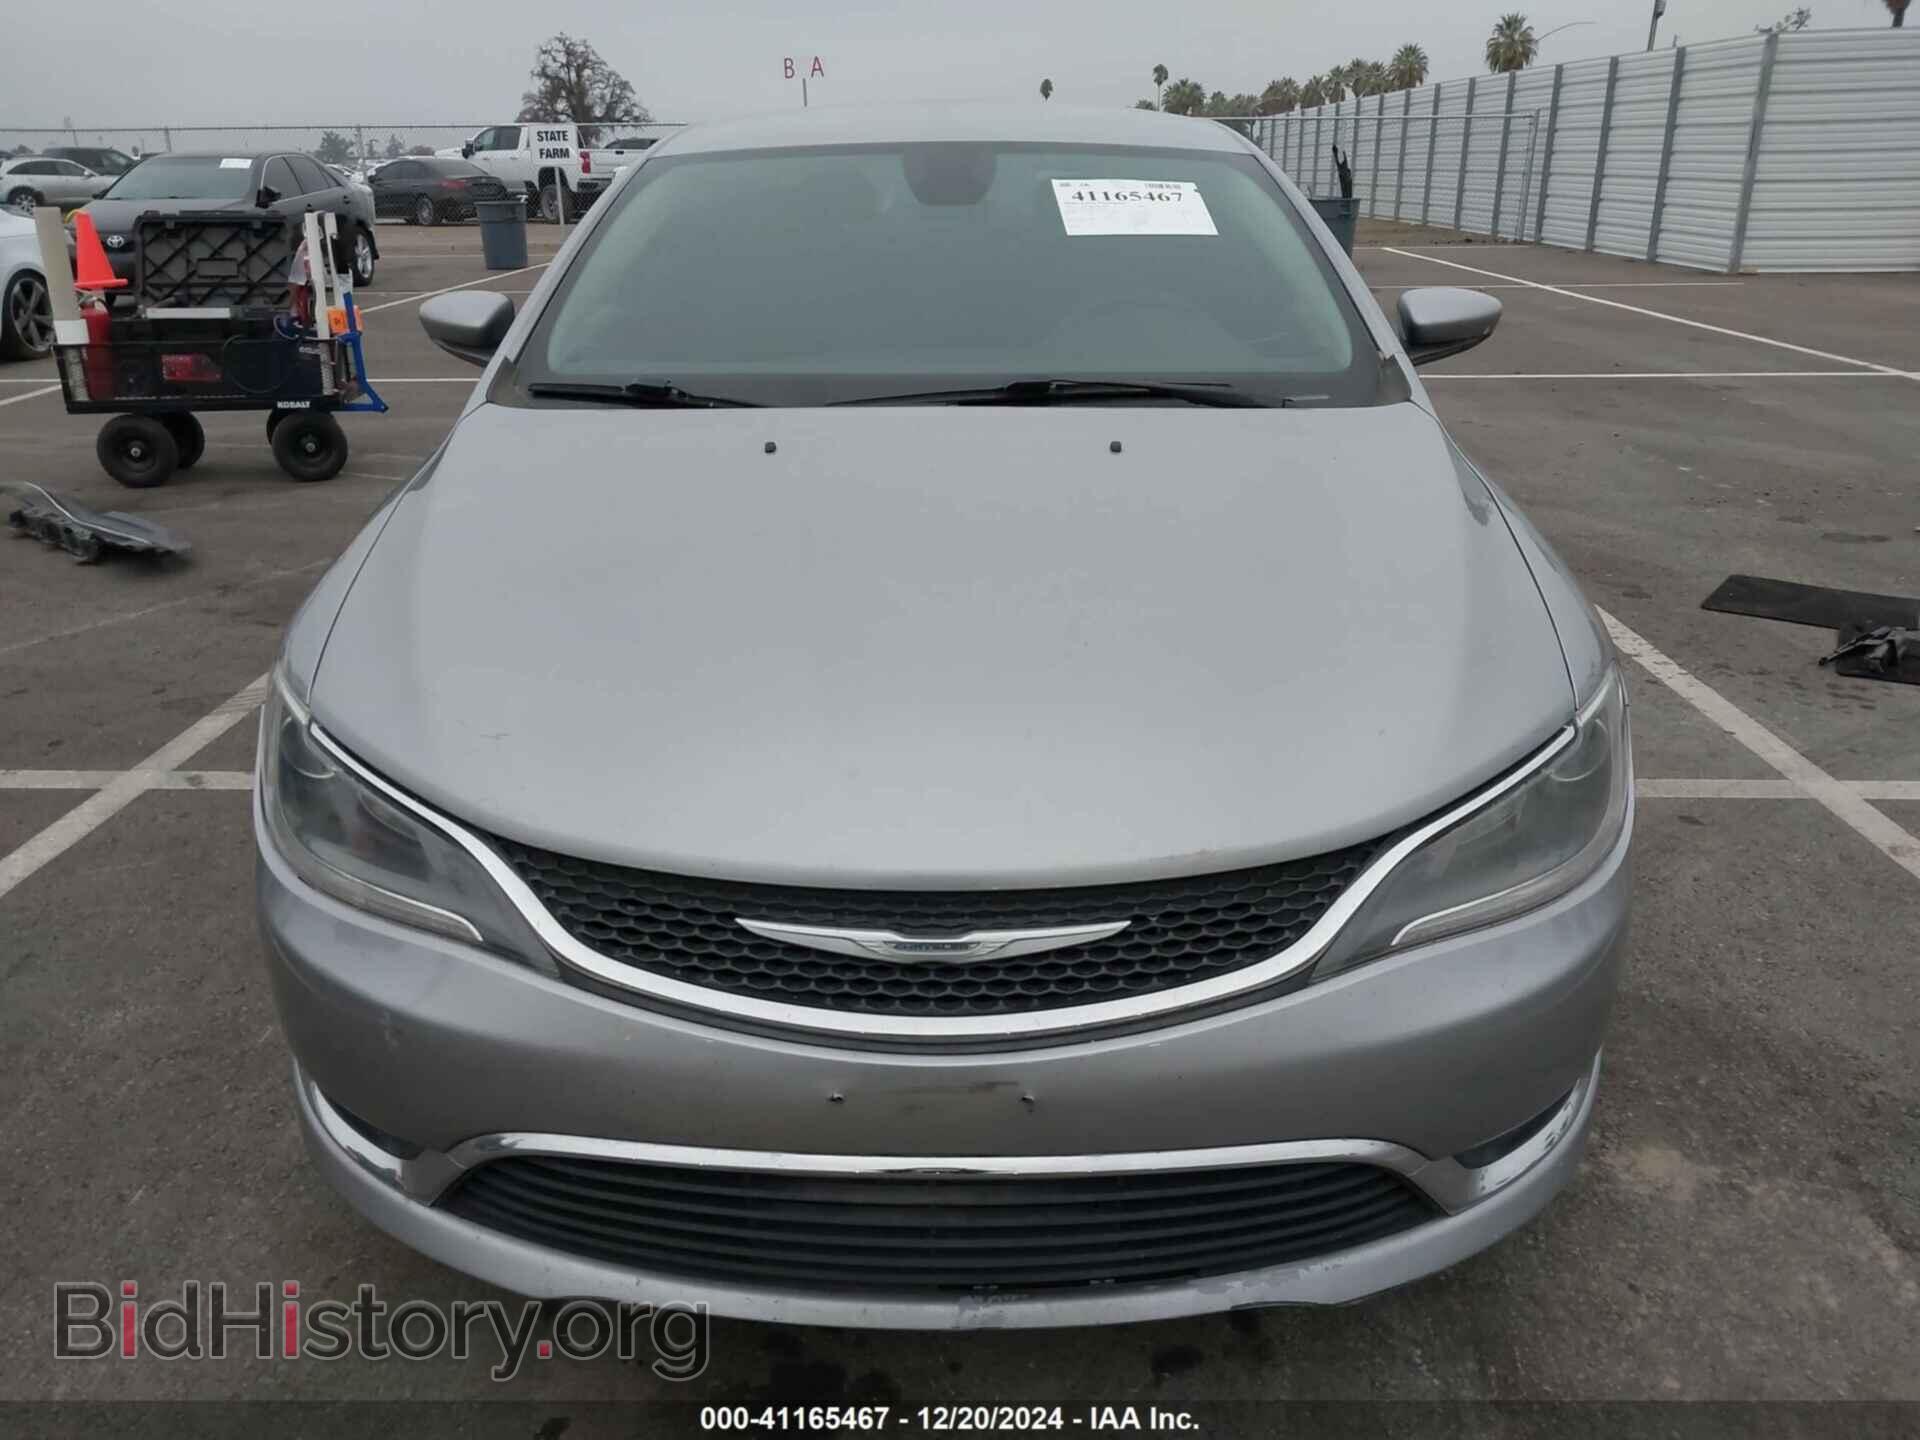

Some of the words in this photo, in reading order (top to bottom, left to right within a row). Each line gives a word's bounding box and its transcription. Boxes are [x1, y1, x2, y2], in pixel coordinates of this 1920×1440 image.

[784, 57, 795, 79] B
[811, 55, 824, 78] A
[536, 130, 569, 142] STATE
[539, 147, 570, 159] FARM
[1072, 190, 1182, 202] 41165467
